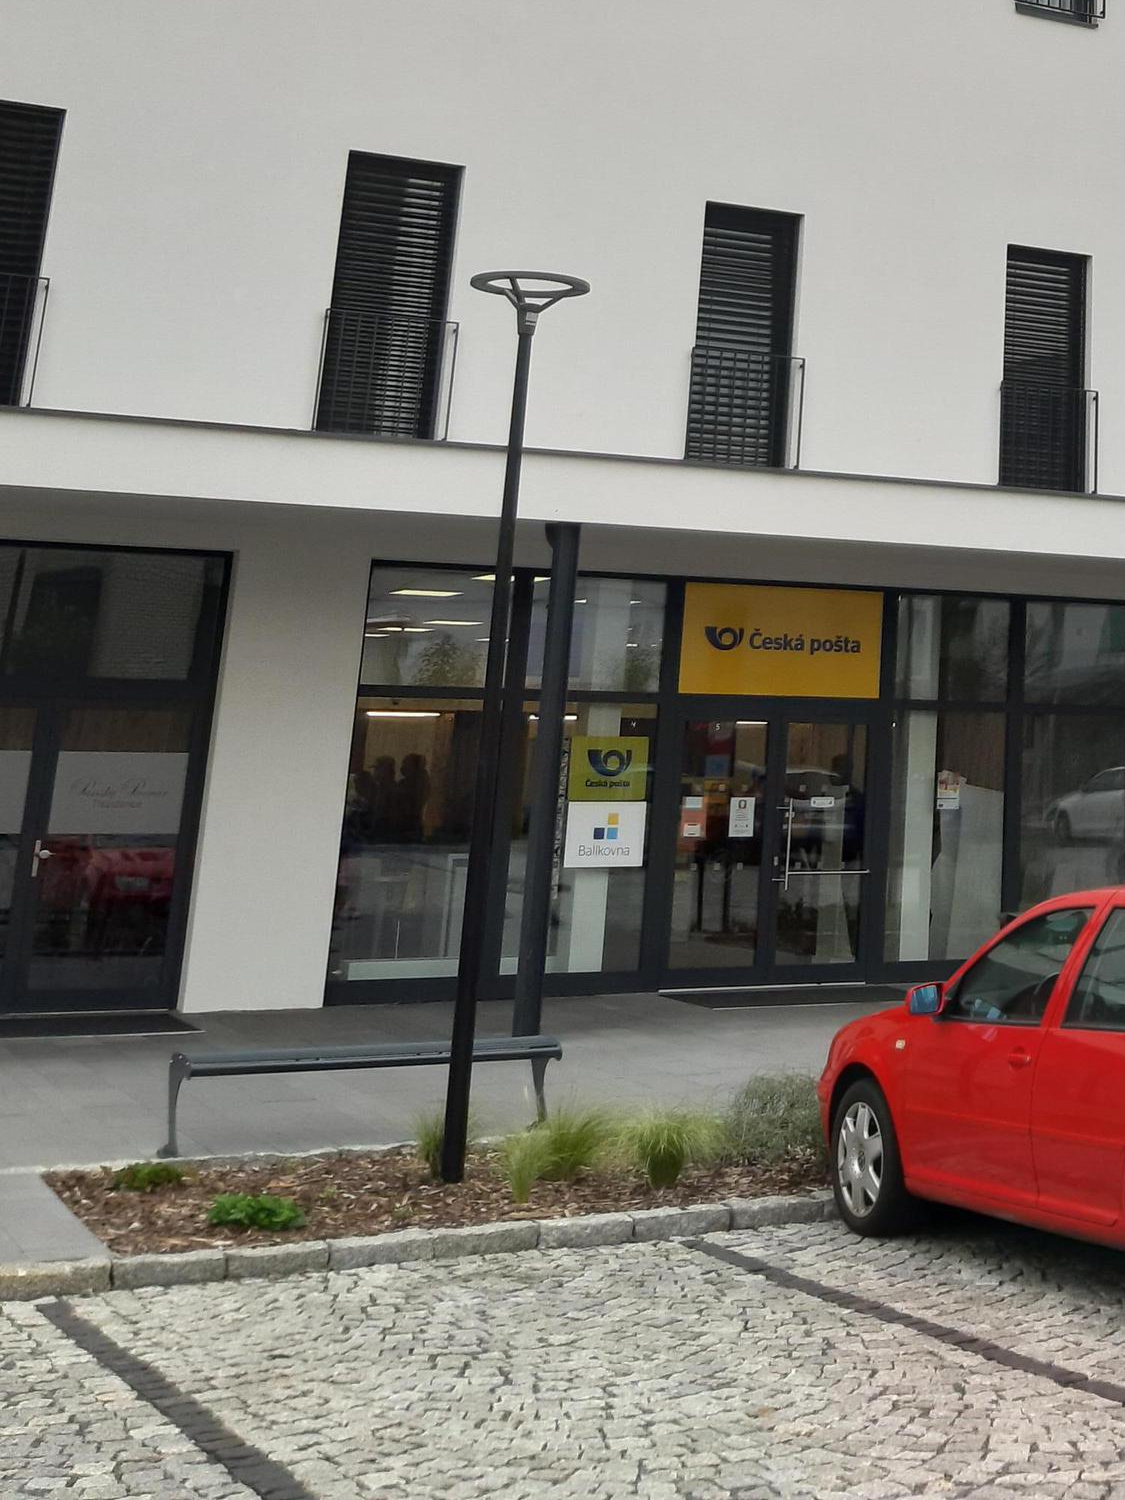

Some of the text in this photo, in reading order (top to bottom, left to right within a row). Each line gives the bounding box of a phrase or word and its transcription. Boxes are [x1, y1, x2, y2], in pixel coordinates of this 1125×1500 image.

[749, 628, 861, 655] Česká pošta
[585, 779, 631, 789] Česká pošta
